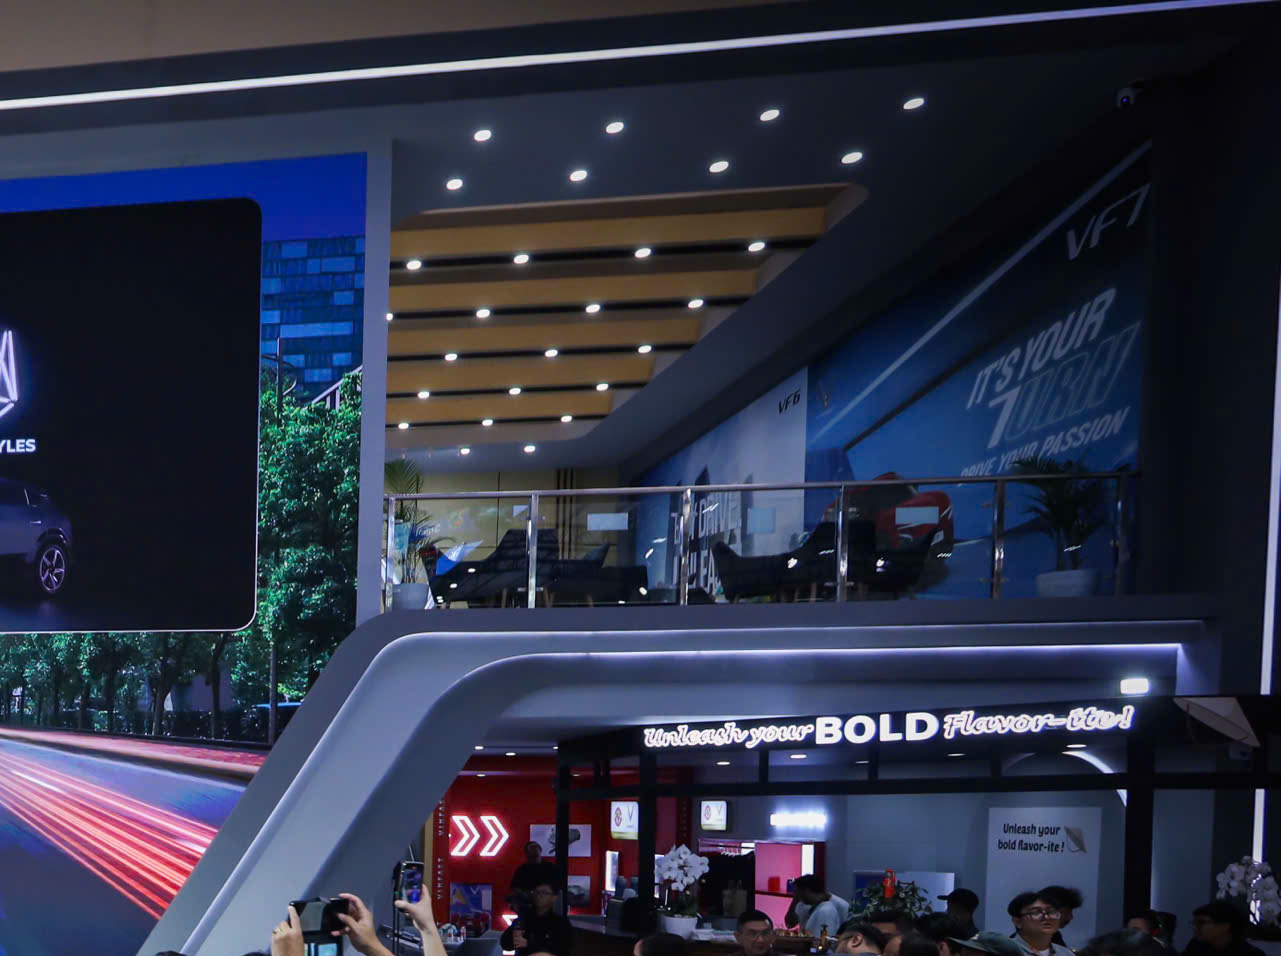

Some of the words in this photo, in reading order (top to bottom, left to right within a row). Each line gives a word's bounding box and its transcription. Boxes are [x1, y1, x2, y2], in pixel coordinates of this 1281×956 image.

[967, 347, 1021, 410] IT'S
[1018, 287, 1117, 382] YOUR
[1037, 405, 1132, 464] PASSION
[643, 721, 748, 748] Unleash
[746, 723, 814, 749] your
[815, 712, 940, 745] BOLD
[997, 839, 1016, 850] bold
[1003, 823, 1036, 835] Unleash
[1038, 826, 1061, 837] your
